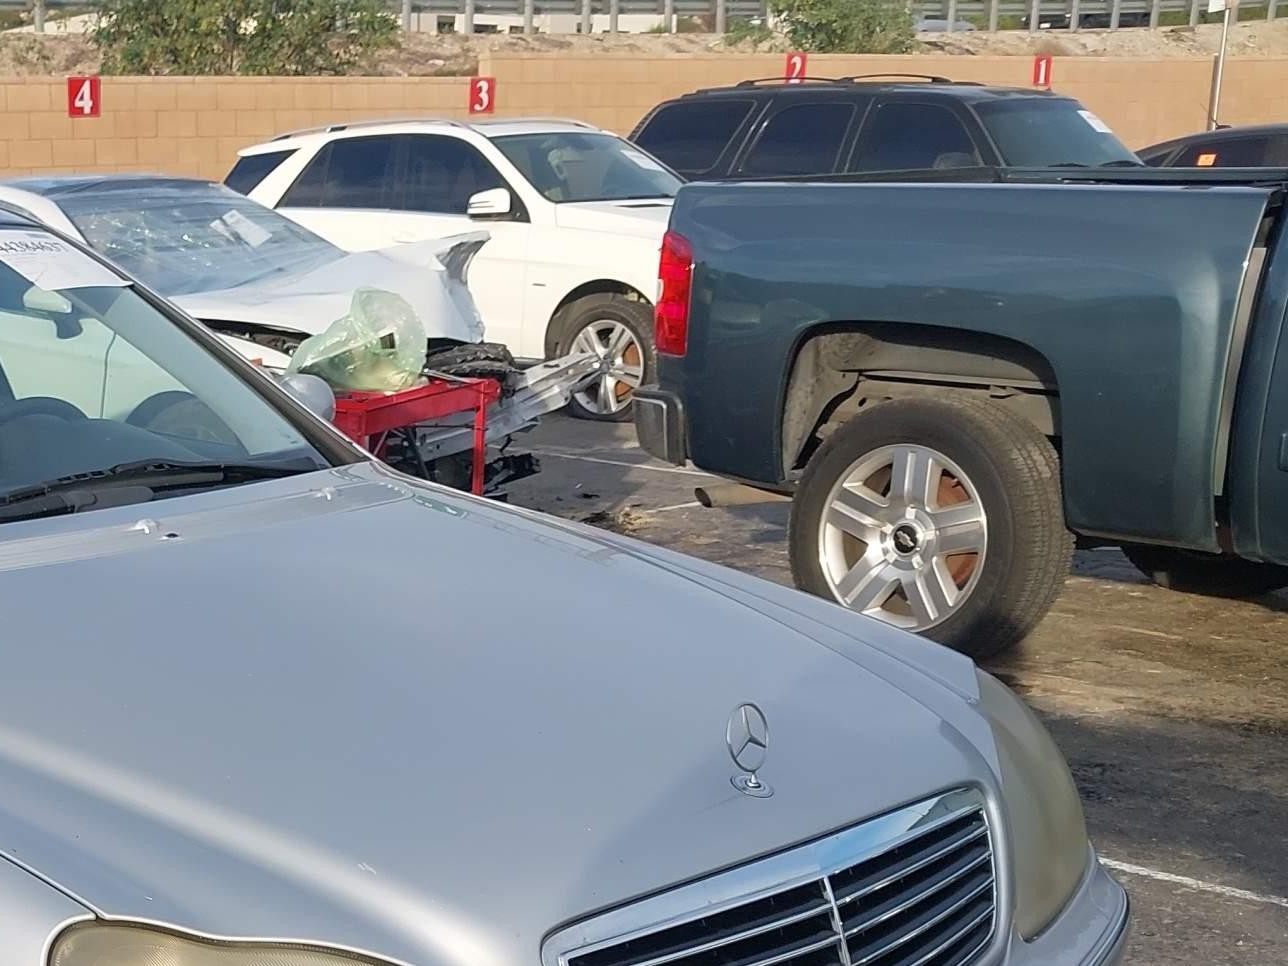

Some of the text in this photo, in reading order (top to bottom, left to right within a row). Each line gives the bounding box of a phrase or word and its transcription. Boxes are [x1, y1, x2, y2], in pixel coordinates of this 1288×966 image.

[789, 56, 803, 83] 2
[1038, 59, 1047, 84] 1
[74, 80, 94, 114] 4
[473, 80, 490, 111] 3
